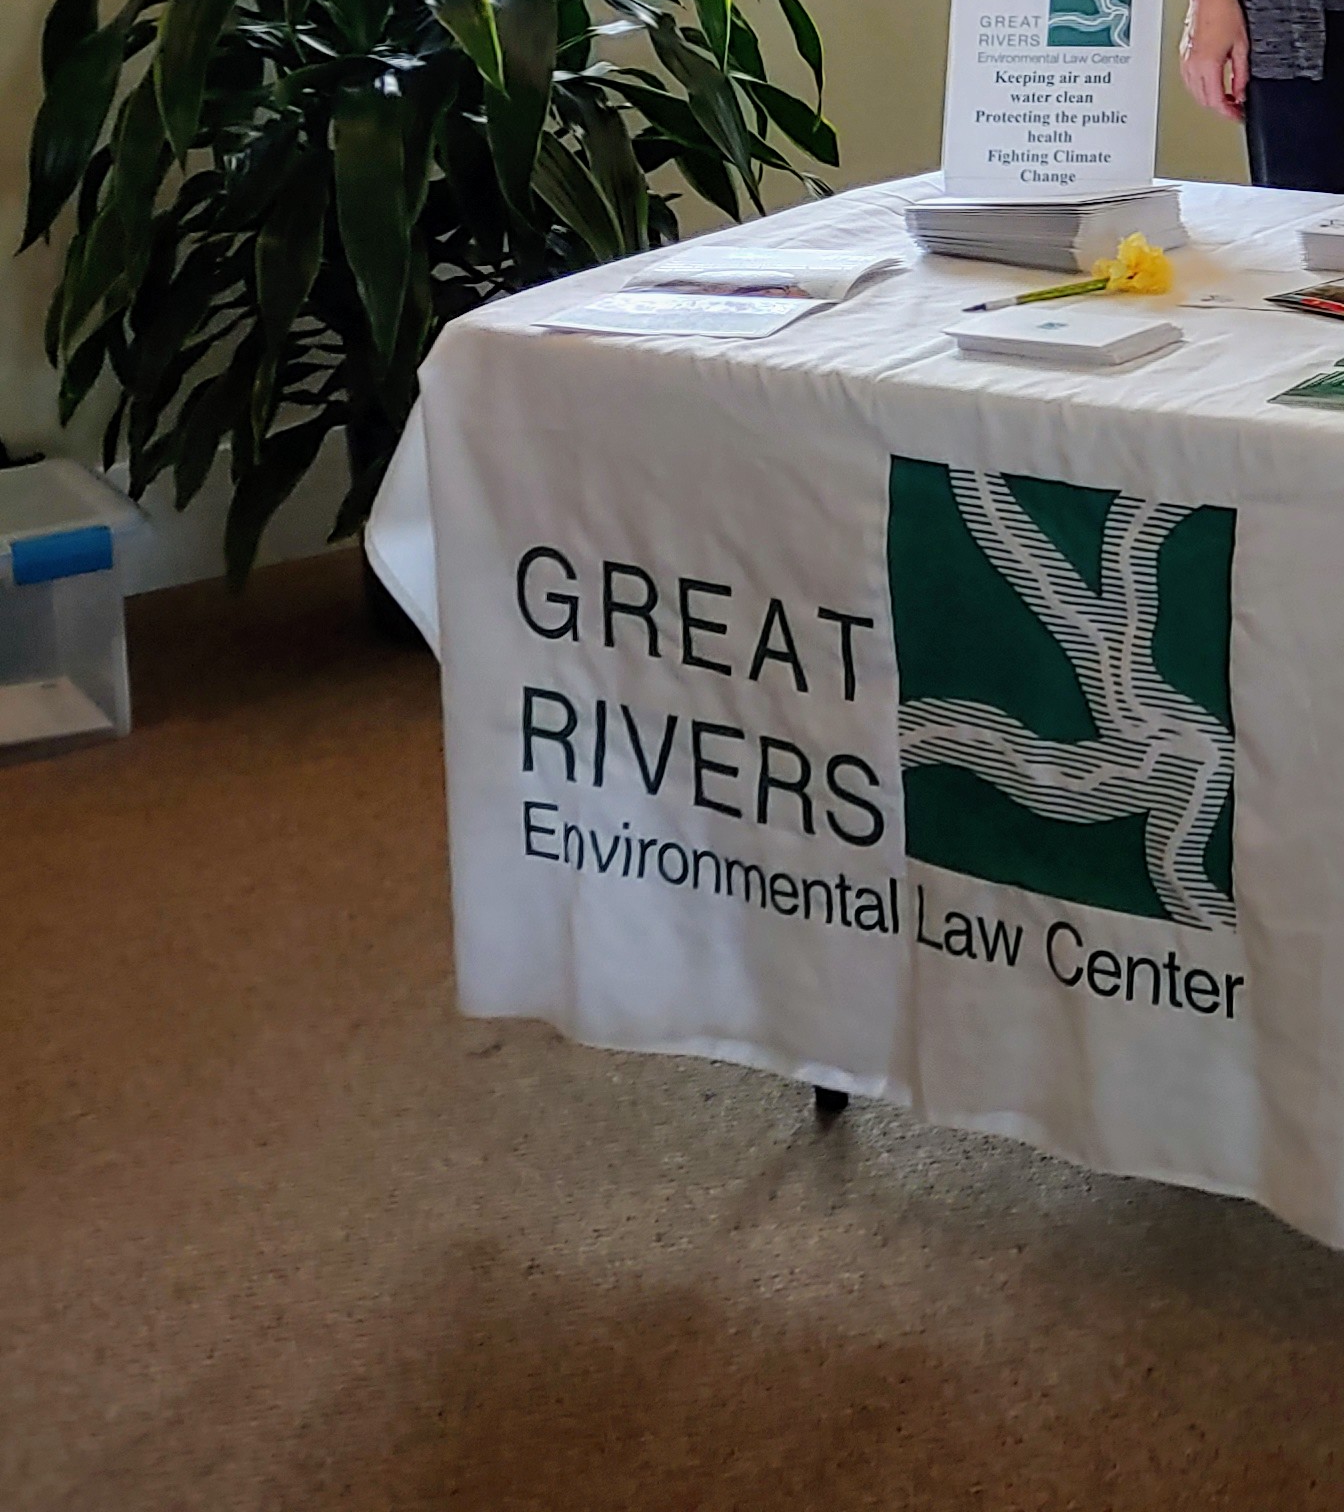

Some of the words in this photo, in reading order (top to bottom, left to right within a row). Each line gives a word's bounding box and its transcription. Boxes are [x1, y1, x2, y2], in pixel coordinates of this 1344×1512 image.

[979, 15, 1043, 29] GREAT
[978, 33, 1041, 48] RIVERS
[977, 51, 1060, 65] Environmental
[1063, 52, 1088, 65] Law
[1091, 52, 1131, 65] Center
[995, 70, 1055, 87] Keeping
[1059, 70, 1079, 84] air
[1084, 70, 1112, 85] and
[1010, 91, 1052, 104] water
[1056, 90, 1094, 104] clean
[975, 110, 1051, 127] Protecting
[1055, 110, 1078, 124] the
[1082, 110, 1128, 127] public
[1027, 129, 1073, 144] health
[987, 148, 1049, 165] Fighting
[1053, 148, 1112, 164] Climate
[1020, 169, 1077, 186] Change
[516, 546, 875, 702] GREAT
[521, 686, 886, 848] RIVERS
[522, 801, 899, 935] Environmental
[915, 883, 1024, 968] Law
[1045, 920, 1245, 1020] Center
